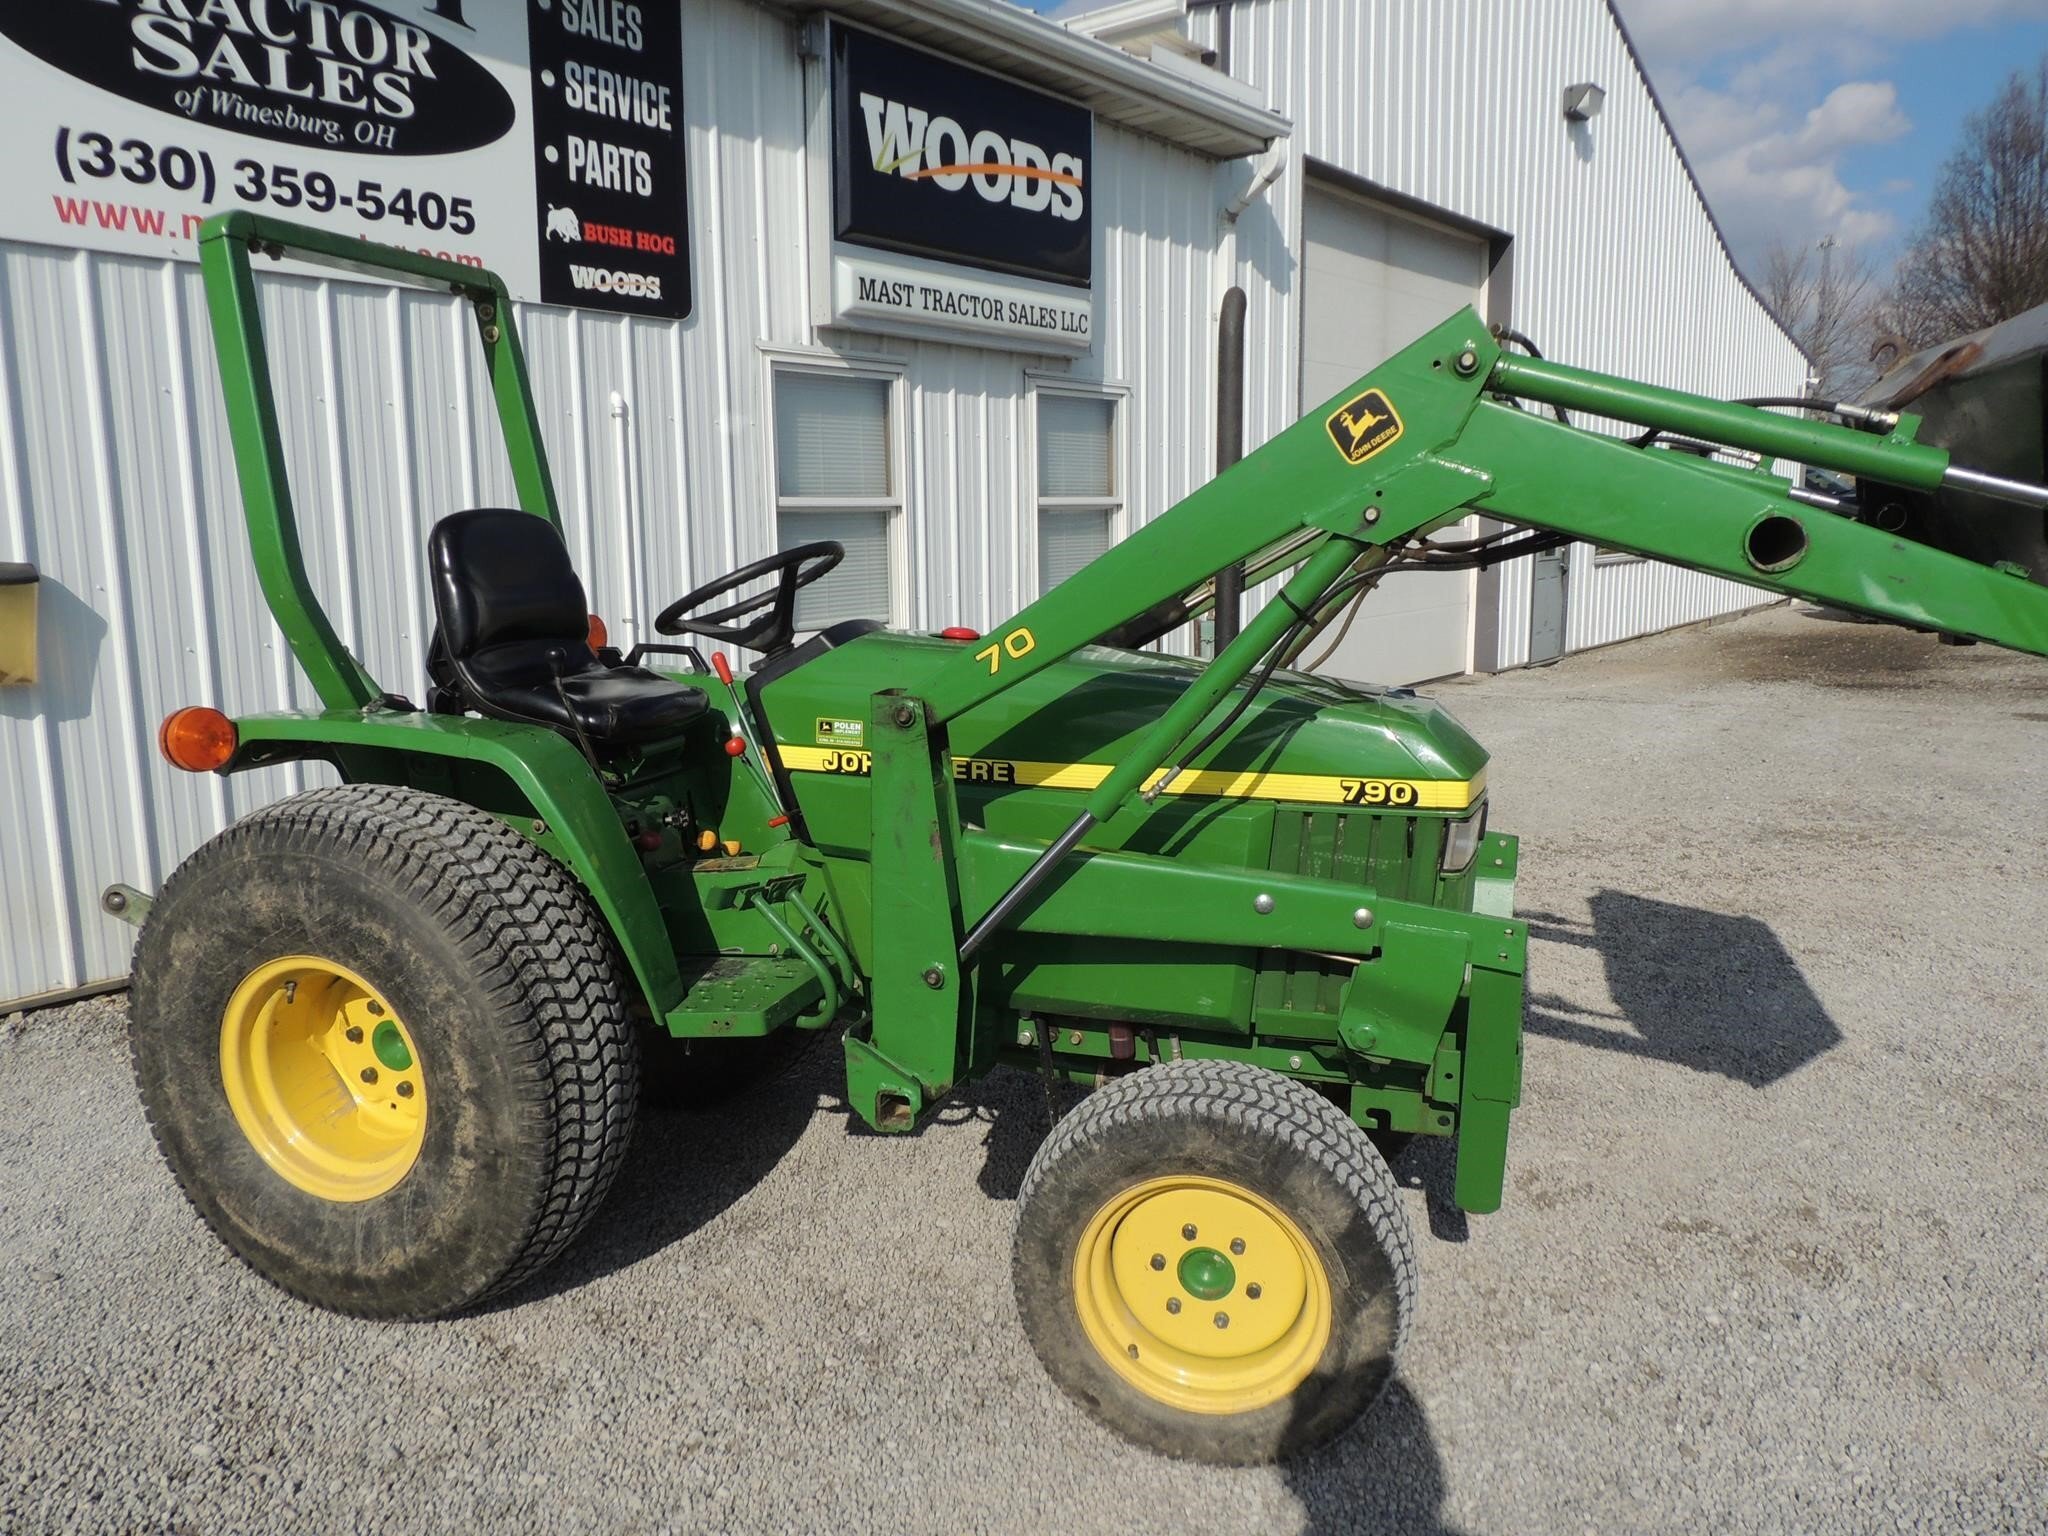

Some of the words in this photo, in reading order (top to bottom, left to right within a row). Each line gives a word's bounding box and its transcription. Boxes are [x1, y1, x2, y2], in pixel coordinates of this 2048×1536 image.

[97, 0, 437, 80] ACTOR
[561, 0, 643, 51] SALES
[131, 13, 416, 119] SALES
[174, 85, 207, 116] of
[211, 89, 345, 144] Winesburg,
[354, 119, 397, 149] OH
[564, 60, 672, 131] SERVICE
[55, 125, 216, 204] (330)
[233, 159, 476, 235] 359-5405
[567, 134, 653, 197] PARTS
[860, 92, 1083, 221] WOODS
[583, 222, 633, 248] BUSH
[636, 231, 676, 256] HOG
[569, 264, 662, 299] WOODS
[858, 276, 914, 307] MAST
[920, 287, 1004, 322] TRACTOR
[1008, 302, 1057, 330] SALES
[1060, 311, 1088, 334] LLC
[1351, 441, 1372, 460] JOHN
[1370, 424, 1397, 446] DEERE
[975, 626, 1037, 677] 70
[822, 751, 871, 774] JOH
[952, 760, 1012, 782] ERE
[1340, 780, 1418, 806] 790
